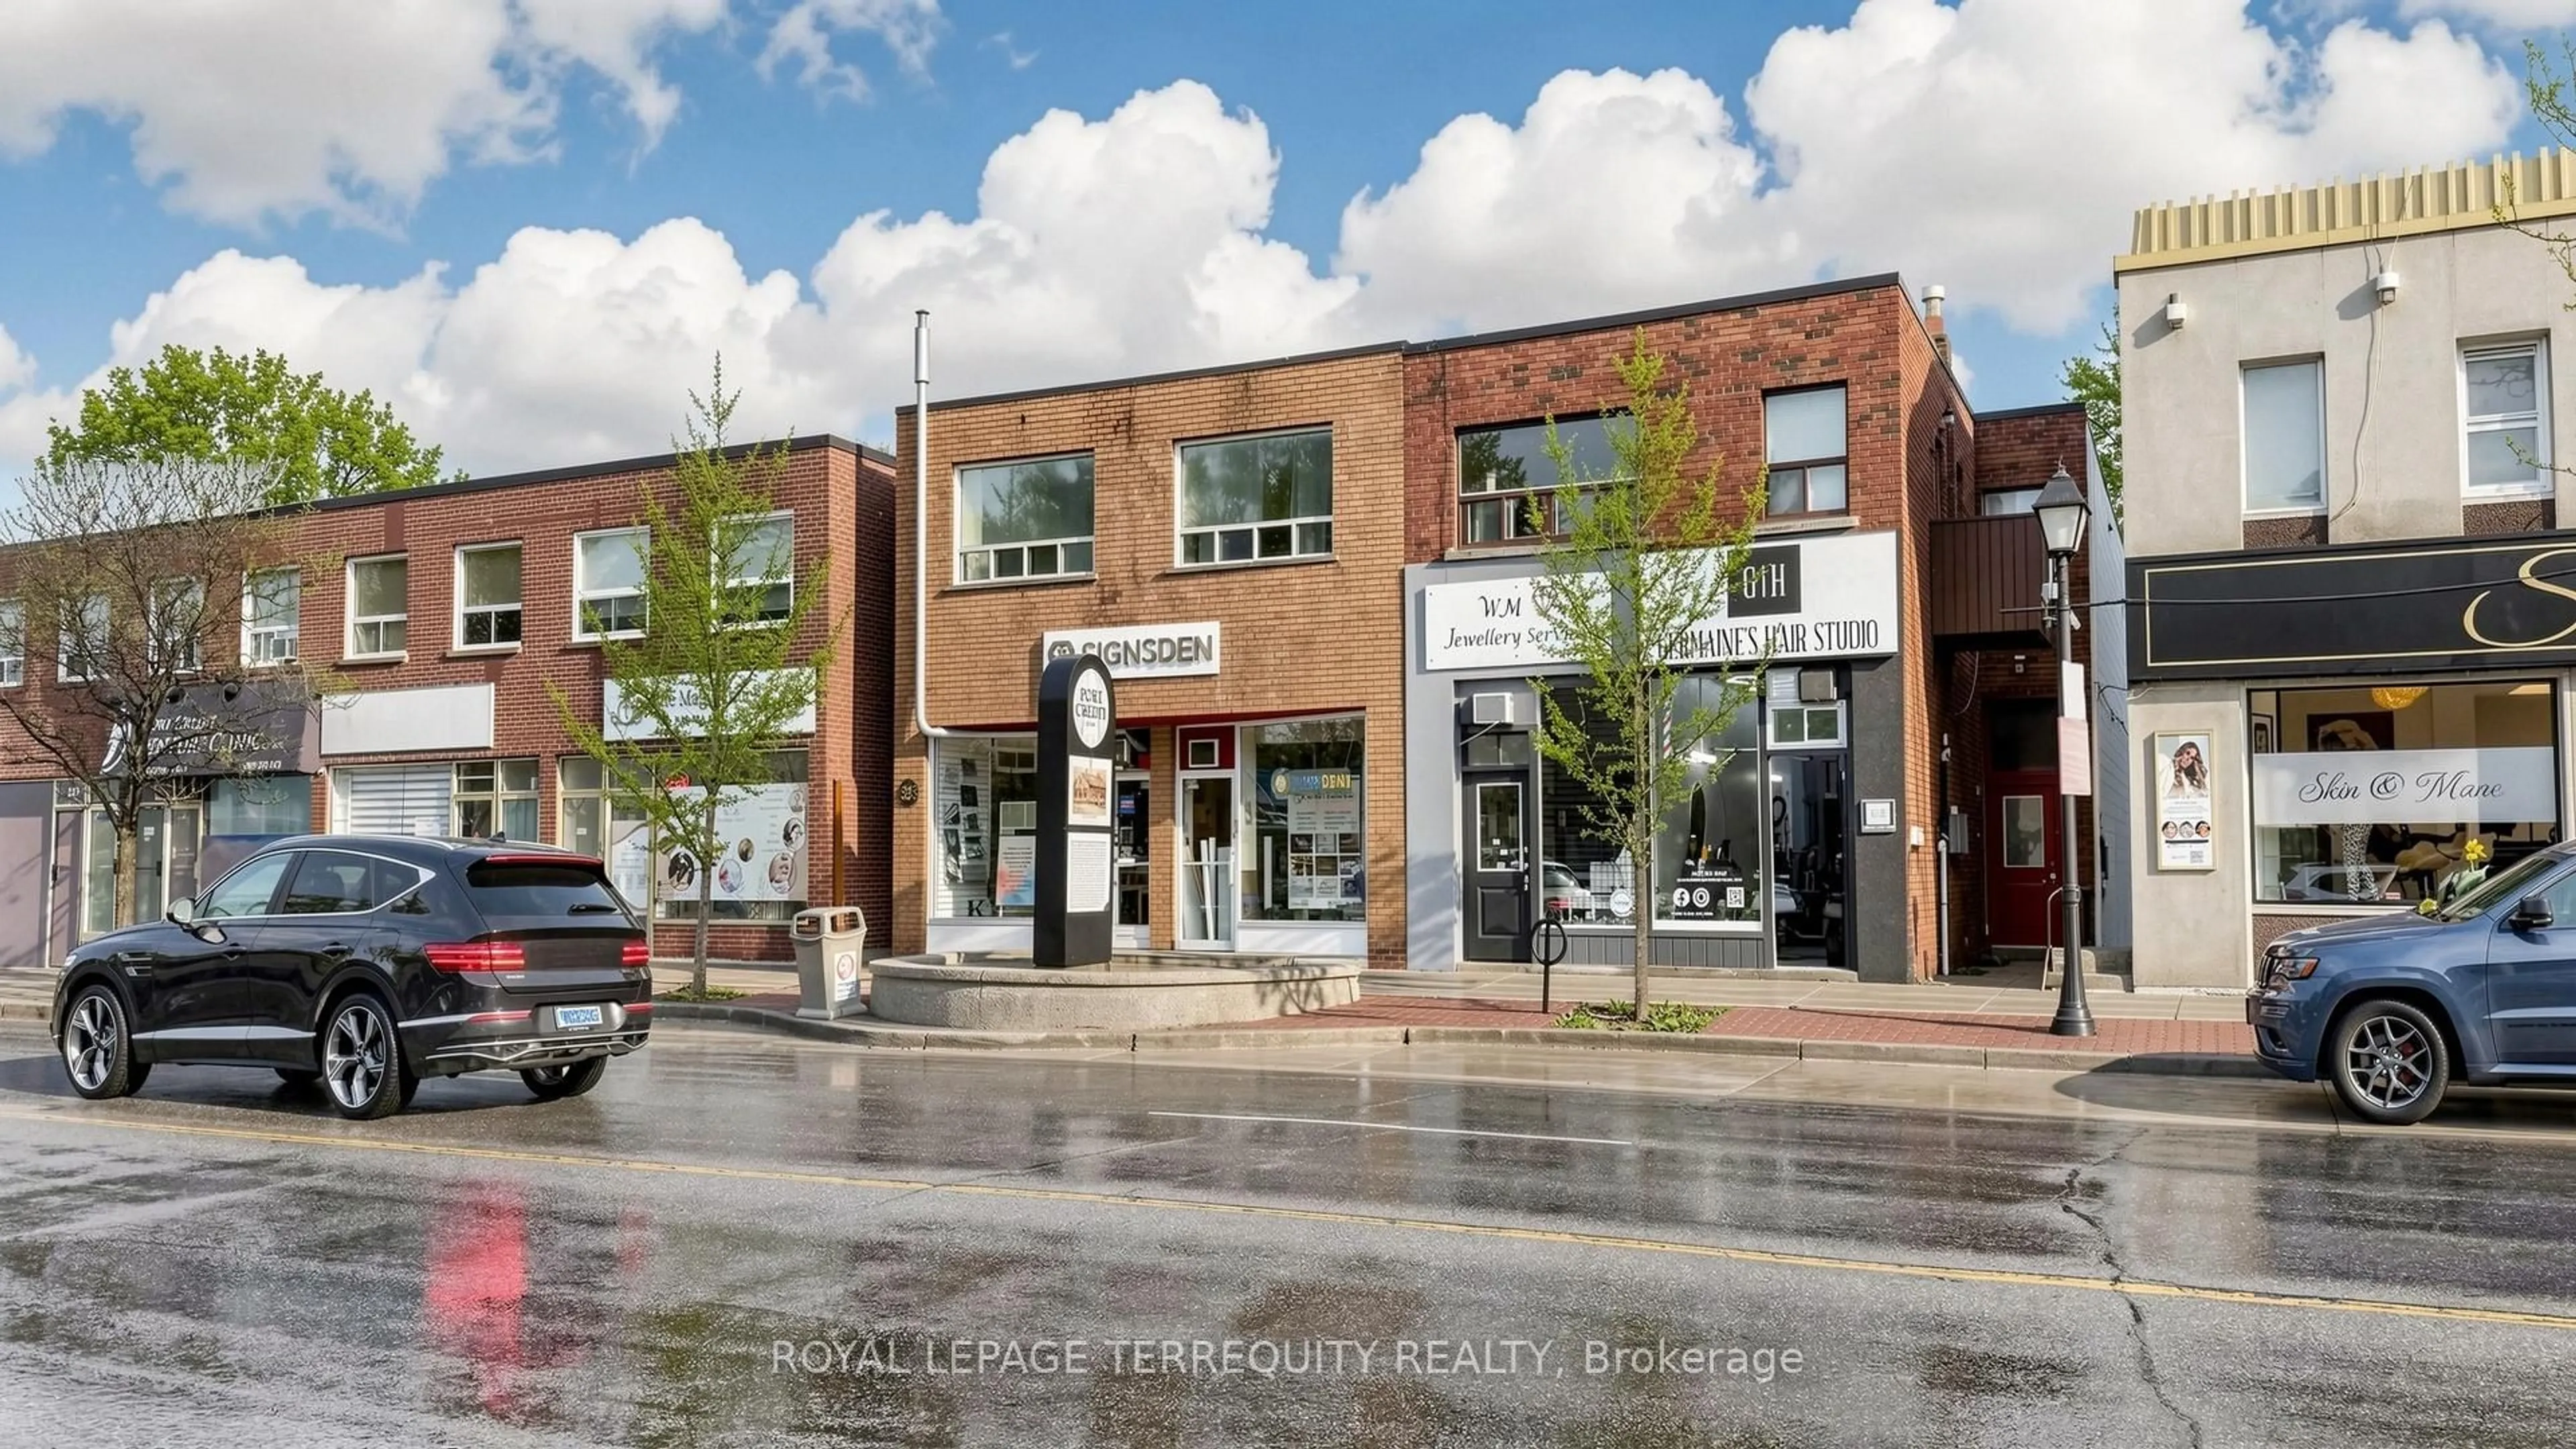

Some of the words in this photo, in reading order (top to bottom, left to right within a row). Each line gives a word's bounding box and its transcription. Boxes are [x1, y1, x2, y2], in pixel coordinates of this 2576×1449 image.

[1479, 596, 1521, 618] WM
[1444, 627, 1521, 649] Jewellery
[1814, 619, 1879, 651] STUDIO
[2298, 771, 2360, 803] Skin
[2415, 770, 2503, 803] Mane
